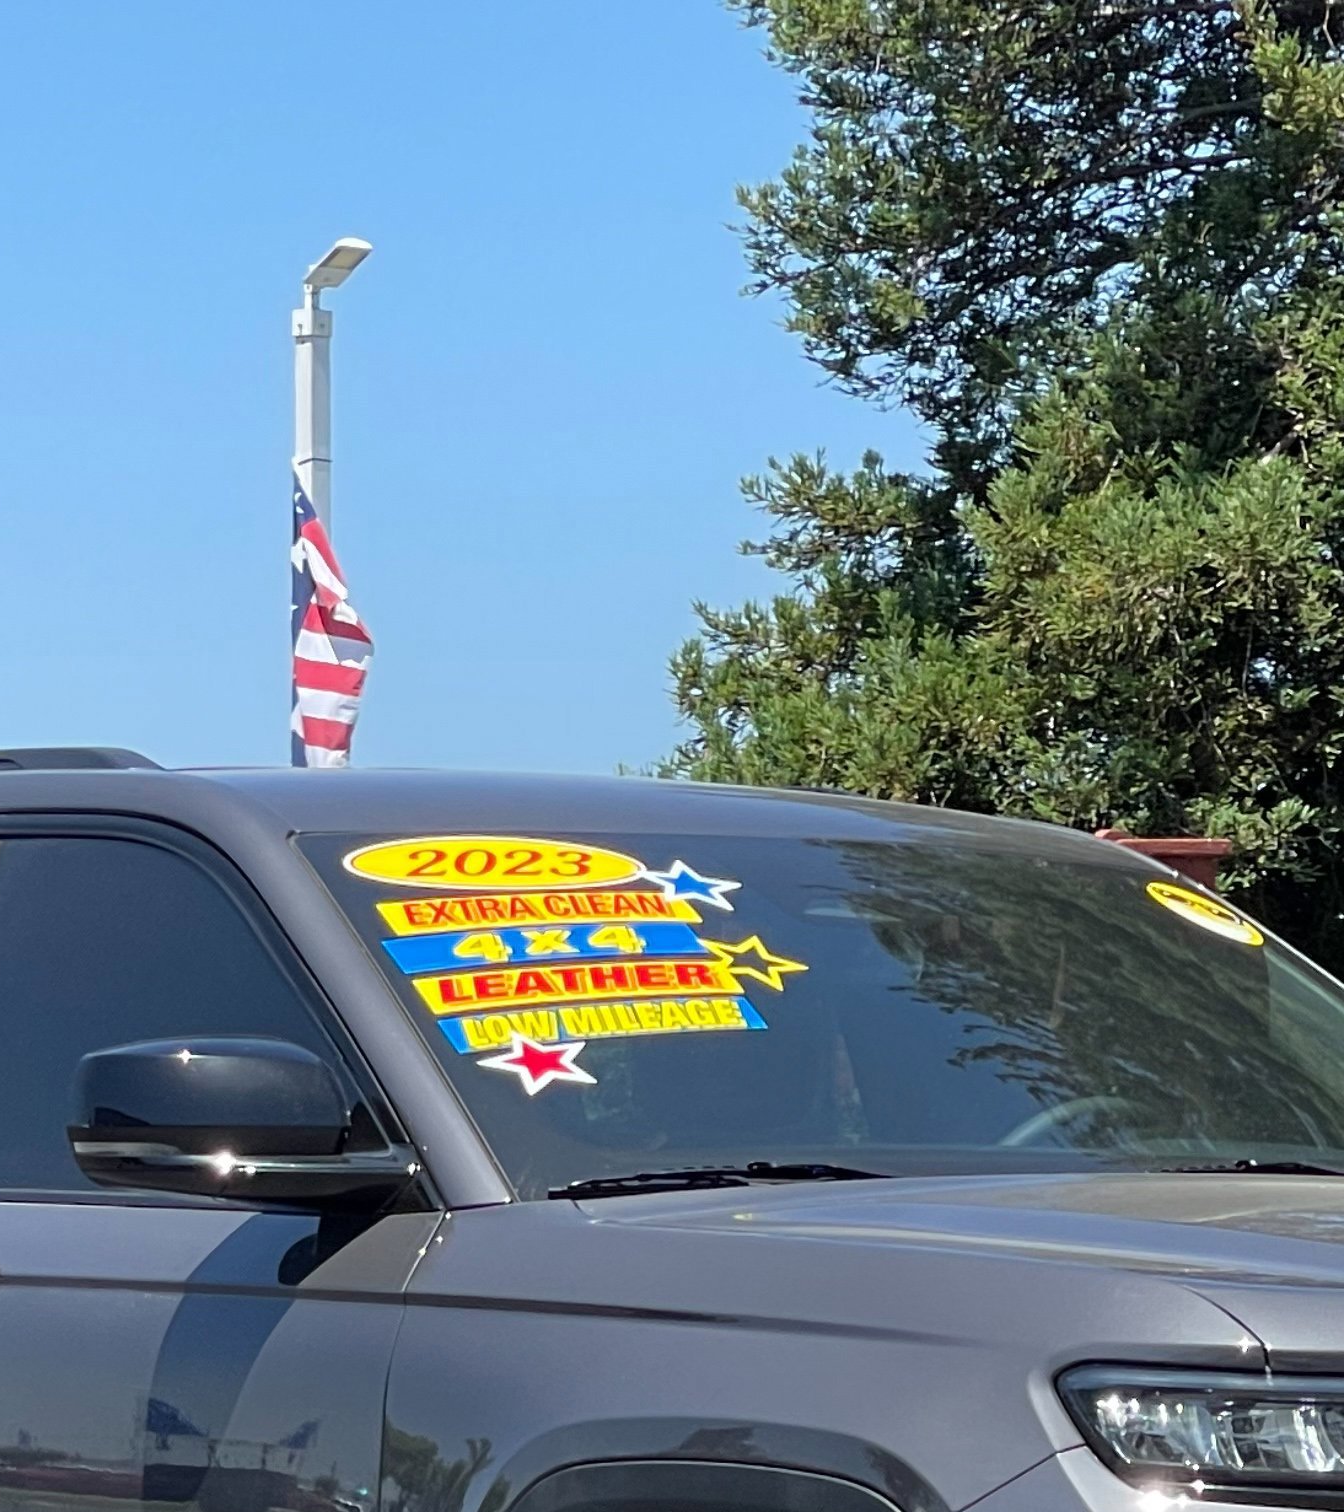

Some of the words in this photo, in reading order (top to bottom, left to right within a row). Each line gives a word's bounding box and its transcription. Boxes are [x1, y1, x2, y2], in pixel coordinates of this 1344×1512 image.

[407, 848, 593, 877] 2023
[403, 894, 539, 926] EXTRA
[545, 892, 669, 919] CLEAN
[439, 963, 718, 1004] LEATHER
[461, 1010, 557, 1048] LOW
[559, 999, 746, 1037] MILEAGE
